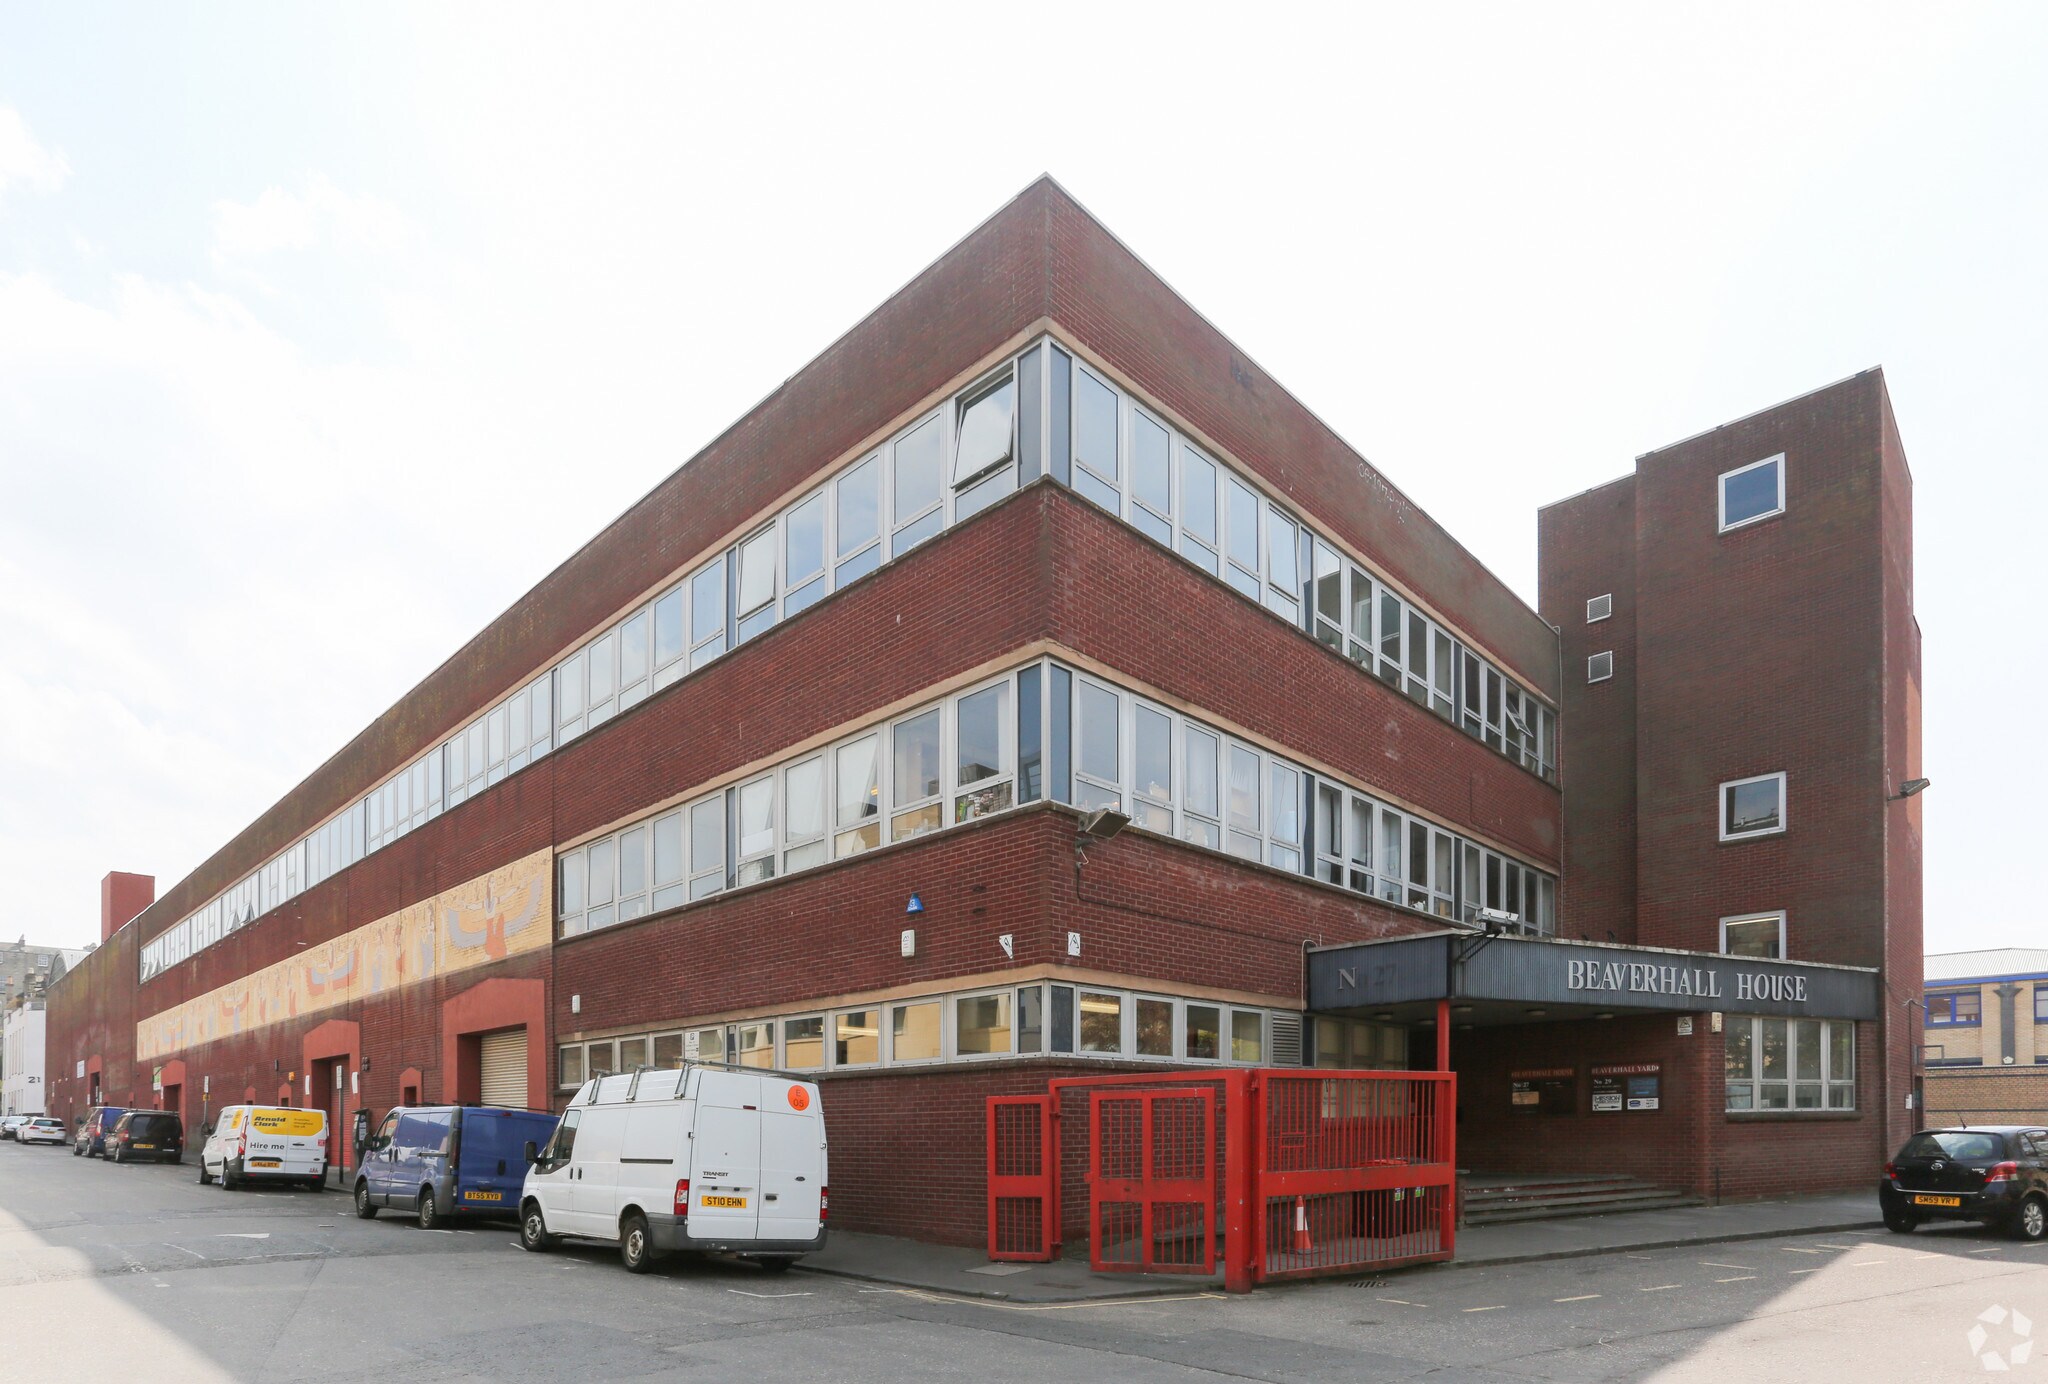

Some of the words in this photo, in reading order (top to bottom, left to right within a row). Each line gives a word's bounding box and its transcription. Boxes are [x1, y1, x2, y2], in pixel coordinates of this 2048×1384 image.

[1567, 959, 1722, 998] BEAVERHALL
[1736, 972, 1807, 1001] HOUSE
[1637, 1064, 1656, 1072] YARD
[28, 1076, 41, 1084] 21
[793, 1098, 804, 1107] 05
[249, 1142, 269, 1150] Hire
[467, 1192, 485, 1200] BT55
[1918, 1196, 1939, 1204] SM59
[706, 1196, 726, 1206] ST10
[726, 1197, 742, 1206] EHN
